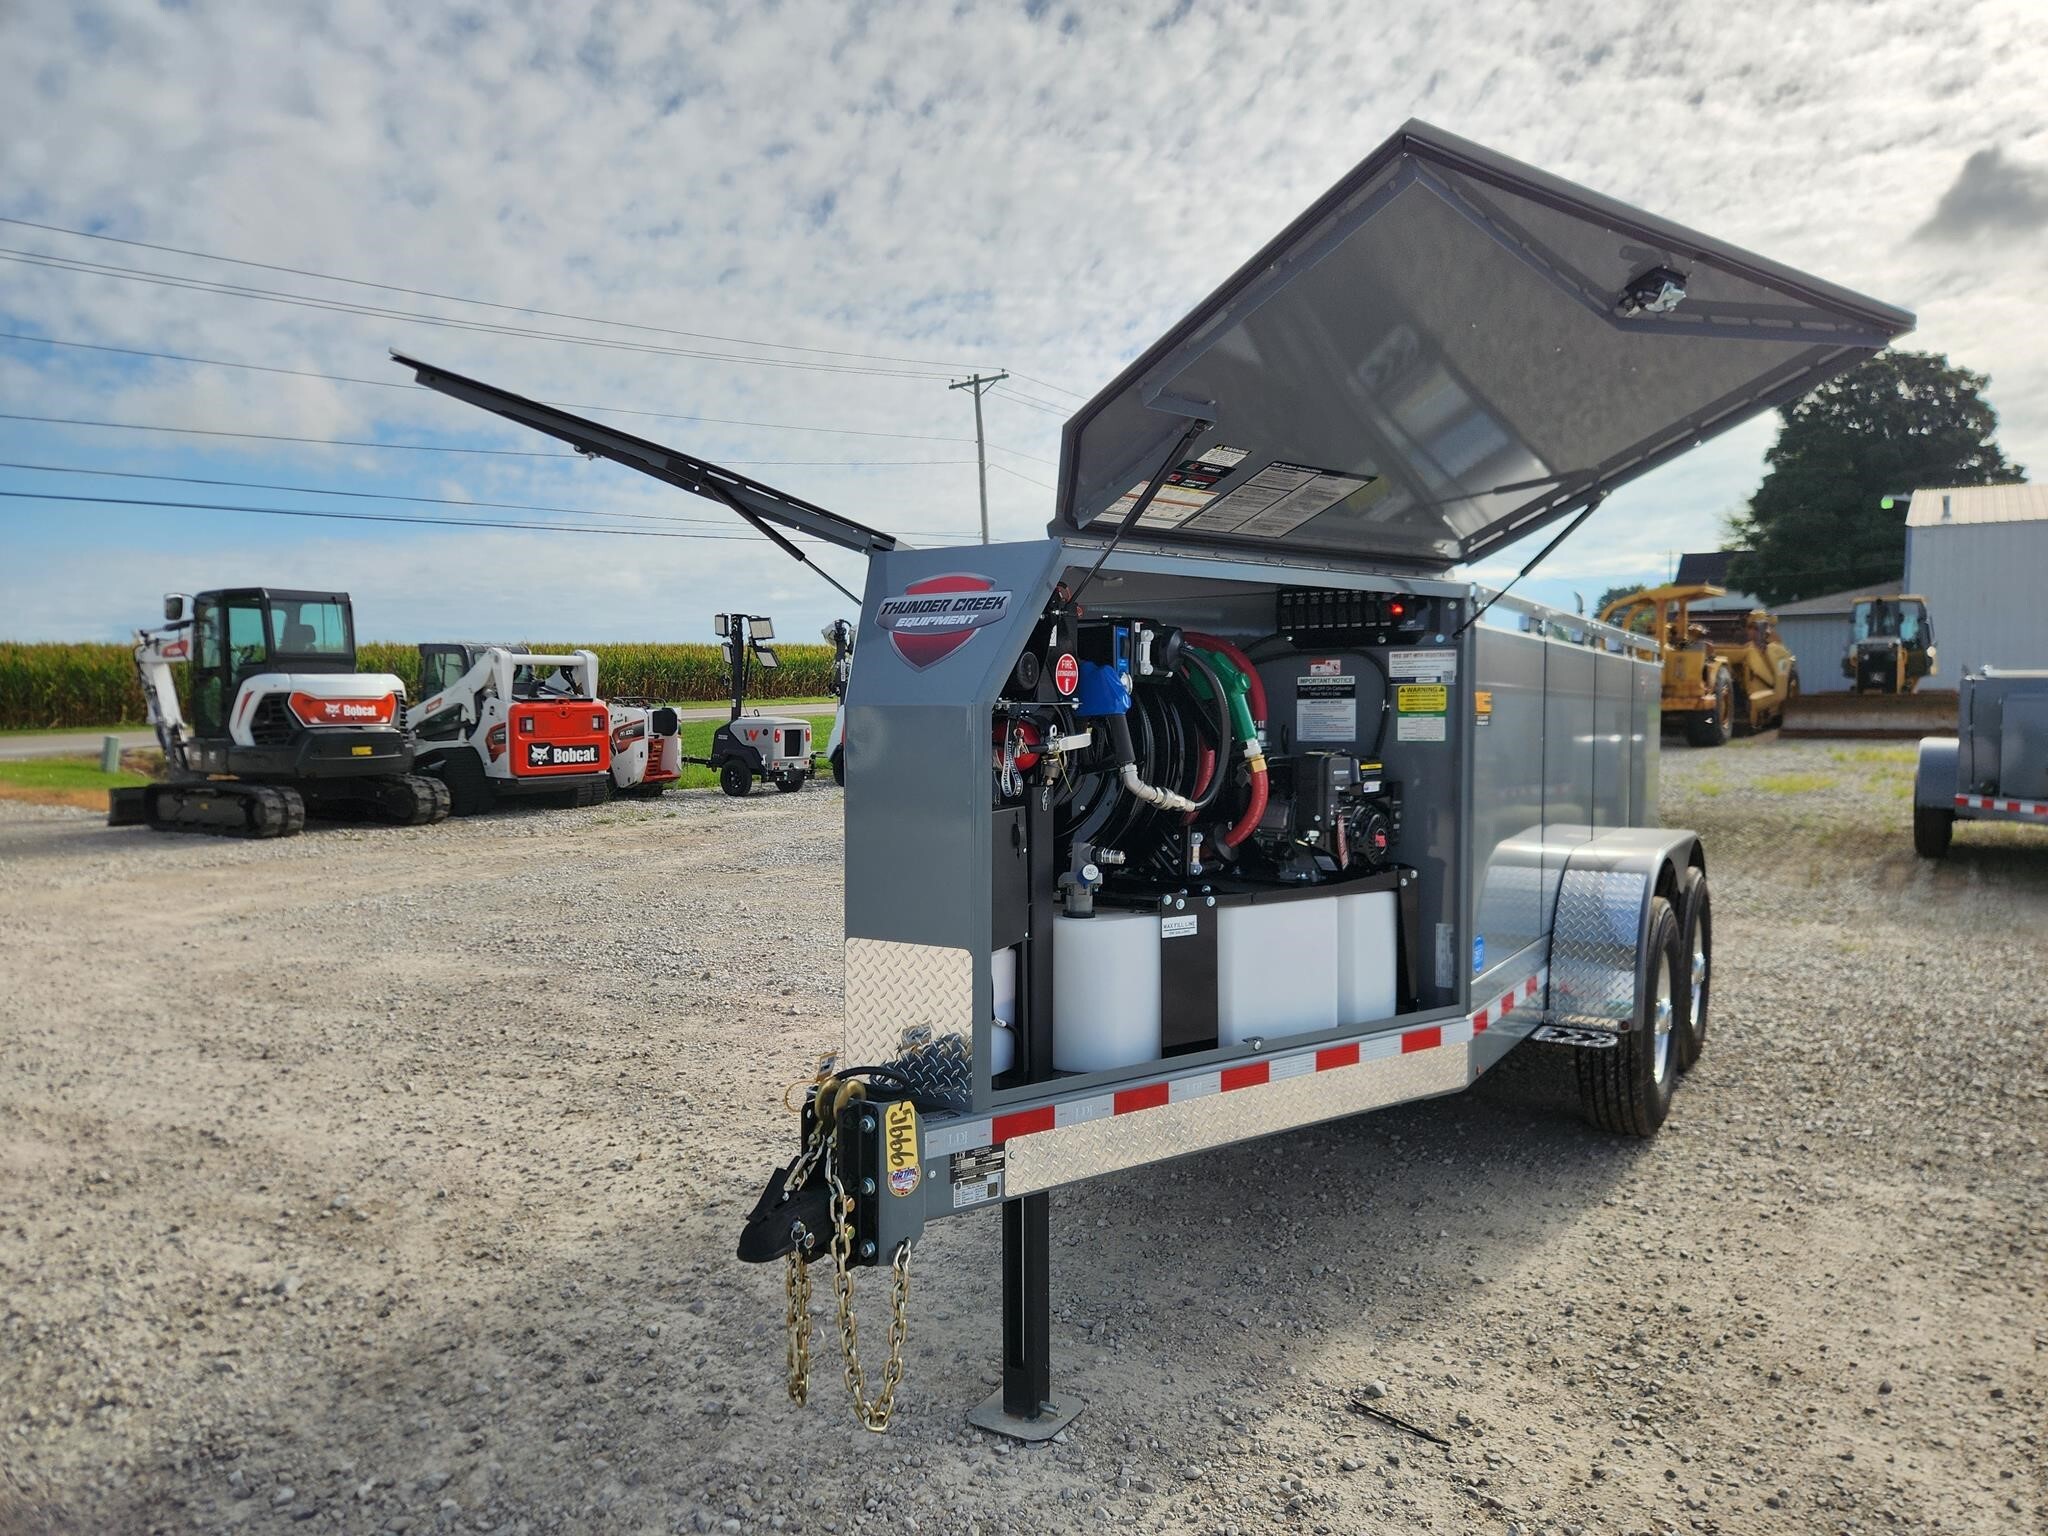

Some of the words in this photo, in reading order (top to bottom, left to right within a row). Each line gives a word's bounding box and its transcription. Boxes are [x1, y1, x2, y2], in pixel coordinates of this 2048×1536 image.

[881, 599, 952, 615] THUNDER
[951, 596, 1007, 612] CREEK
[895, 614, 979, 627] EQUIPMENT
[1061, 659, 1073, 669] FIRE
[343, 705, 377, 716] Bobcat
[553, 747, 595, 764] Bobcat
[889, 1108, 915, 1167] 5666
